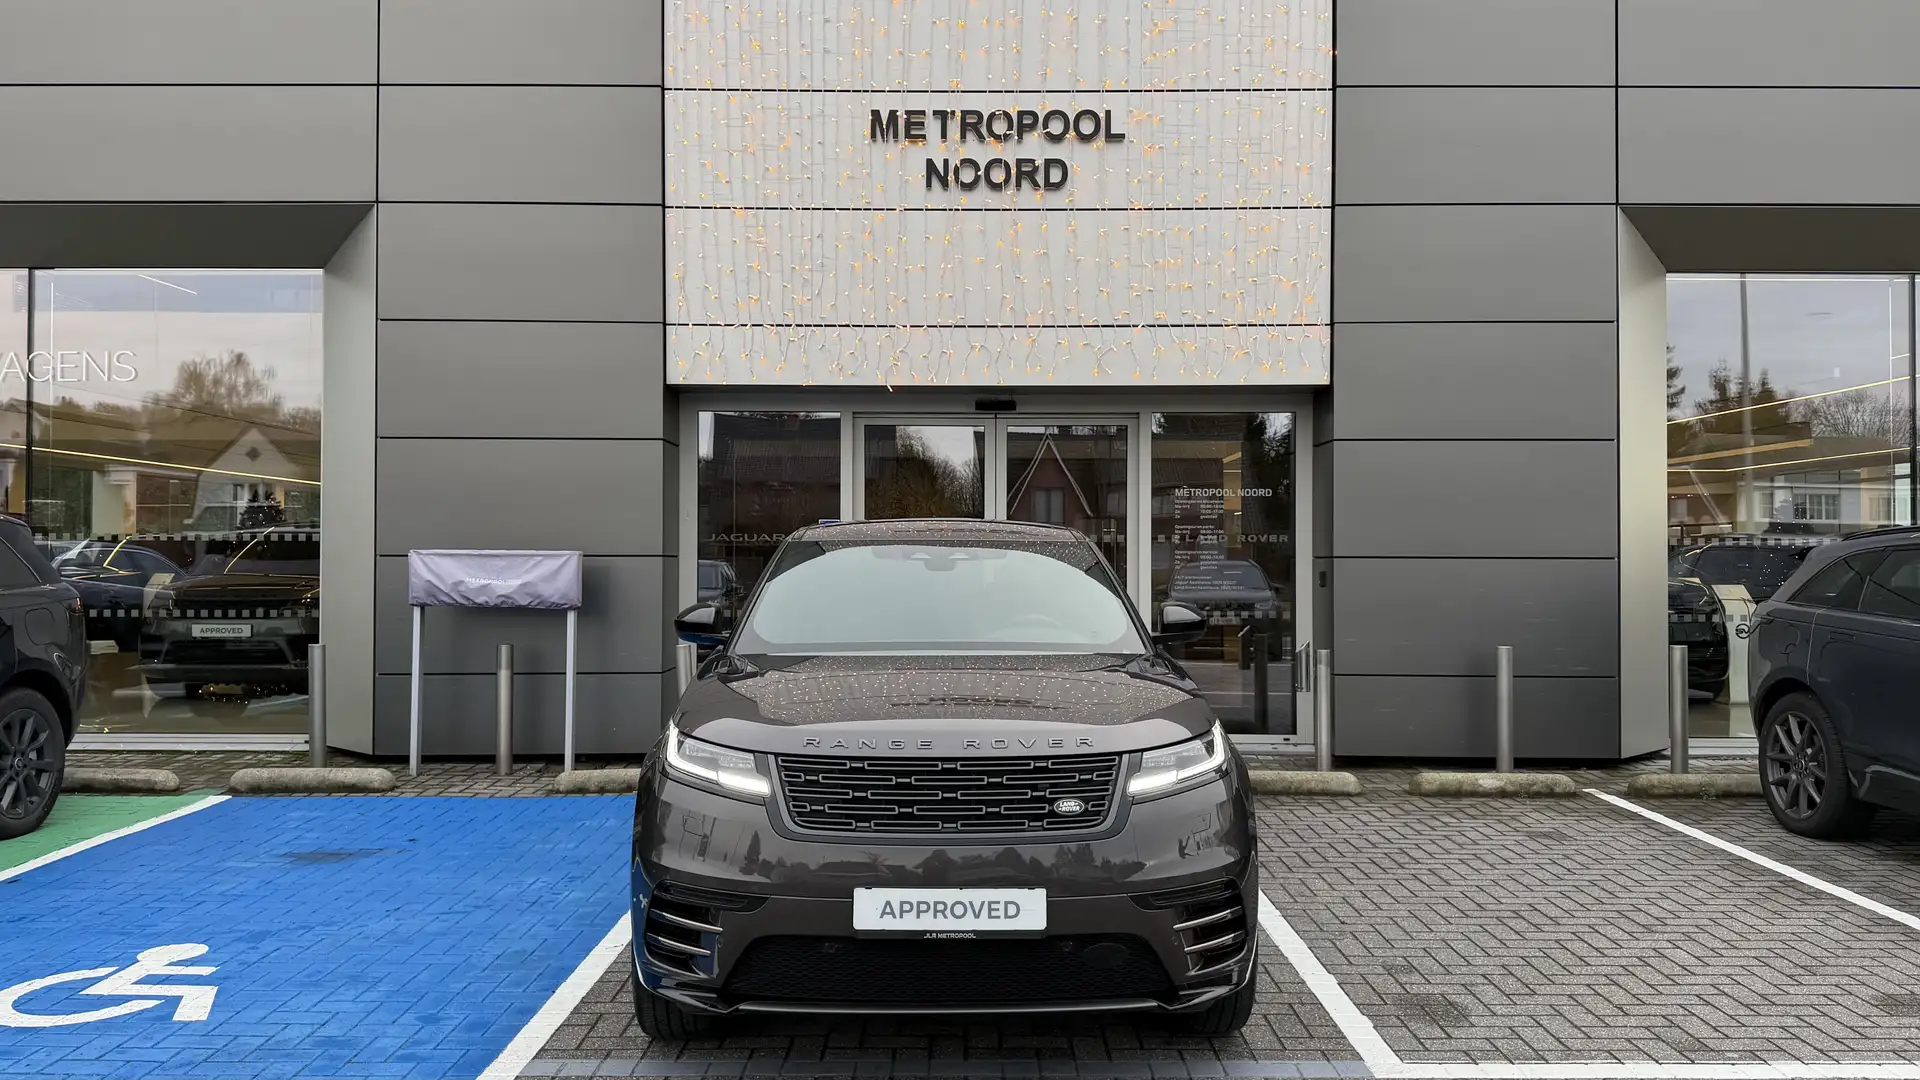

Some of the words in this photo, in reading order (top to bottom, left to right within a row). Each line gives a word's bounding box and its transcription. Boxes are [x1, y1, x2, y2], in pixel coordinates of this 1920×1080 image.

[870, 109, 1126, 141] METROPOOL
[925, 157, 1069, 190] NOORD
[0, 350, 138, 382] AGENS
[1174, 488, 1236, 497] METROPOOL
[1237, 488, 1273, 497] NOORD
[705, 533, 787, 542] JAGUAR
[1185, 534, 1228, 543] LAND
[1237, 534, 1289, 543] ROVER
[199, 627, 244, 635] APPROVED
[802, 736, 933, 750] RANGE
[963, 736, 1094, 749] ROVER
[879, 900, 1021, 920] APPROVED
